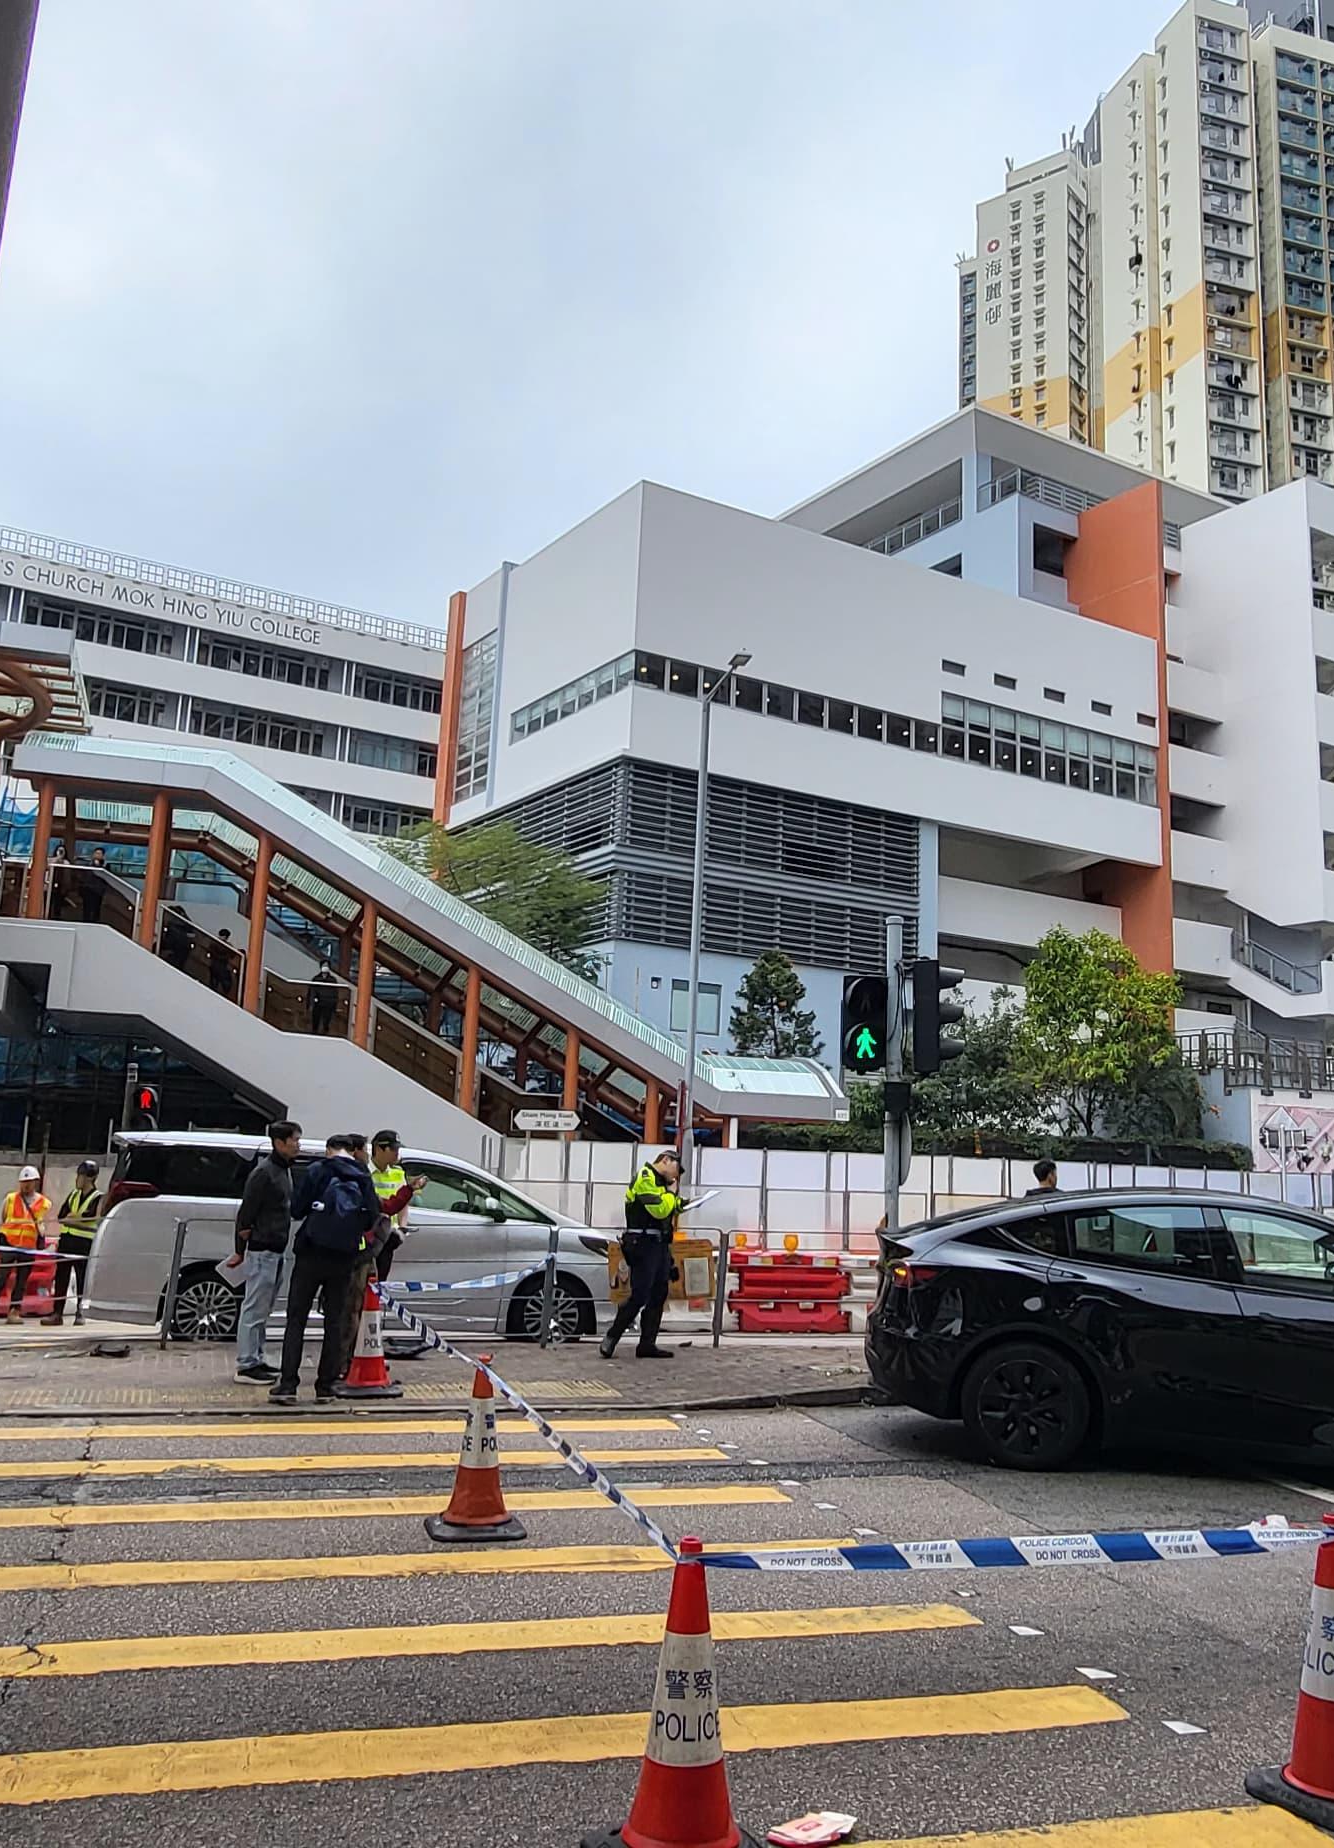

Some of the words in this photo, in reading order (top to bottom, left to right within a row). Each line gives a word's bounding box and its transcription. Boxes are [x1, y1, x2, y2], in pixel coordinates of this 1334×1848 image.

[23, 565, 105, 597] CHURCH
[111, 585, 155, 608] MOK
[162, 596, 207, 620] HING
[216, 607, 244, 627] YIU
[250, 616, 321, 645] COLLEGE
[1257, 1530, 1284, 1539] POLICE
[1020, 1538, 1050, 1547] POLICE
[1036, 1551, 1049, 1560] DO
[1050, 1550, 1067, 1560] NOT
[1071, 1549, 1101, 1559] CROSS
[770, 1558, 785, 1567] DO
[787, 1558, 806, 1566] NOT
[810, 1557, 843, 1567] CROSS
[665, 1668, 713, 1700] 警察
[655, 1709, 720, 1742] POLICE
